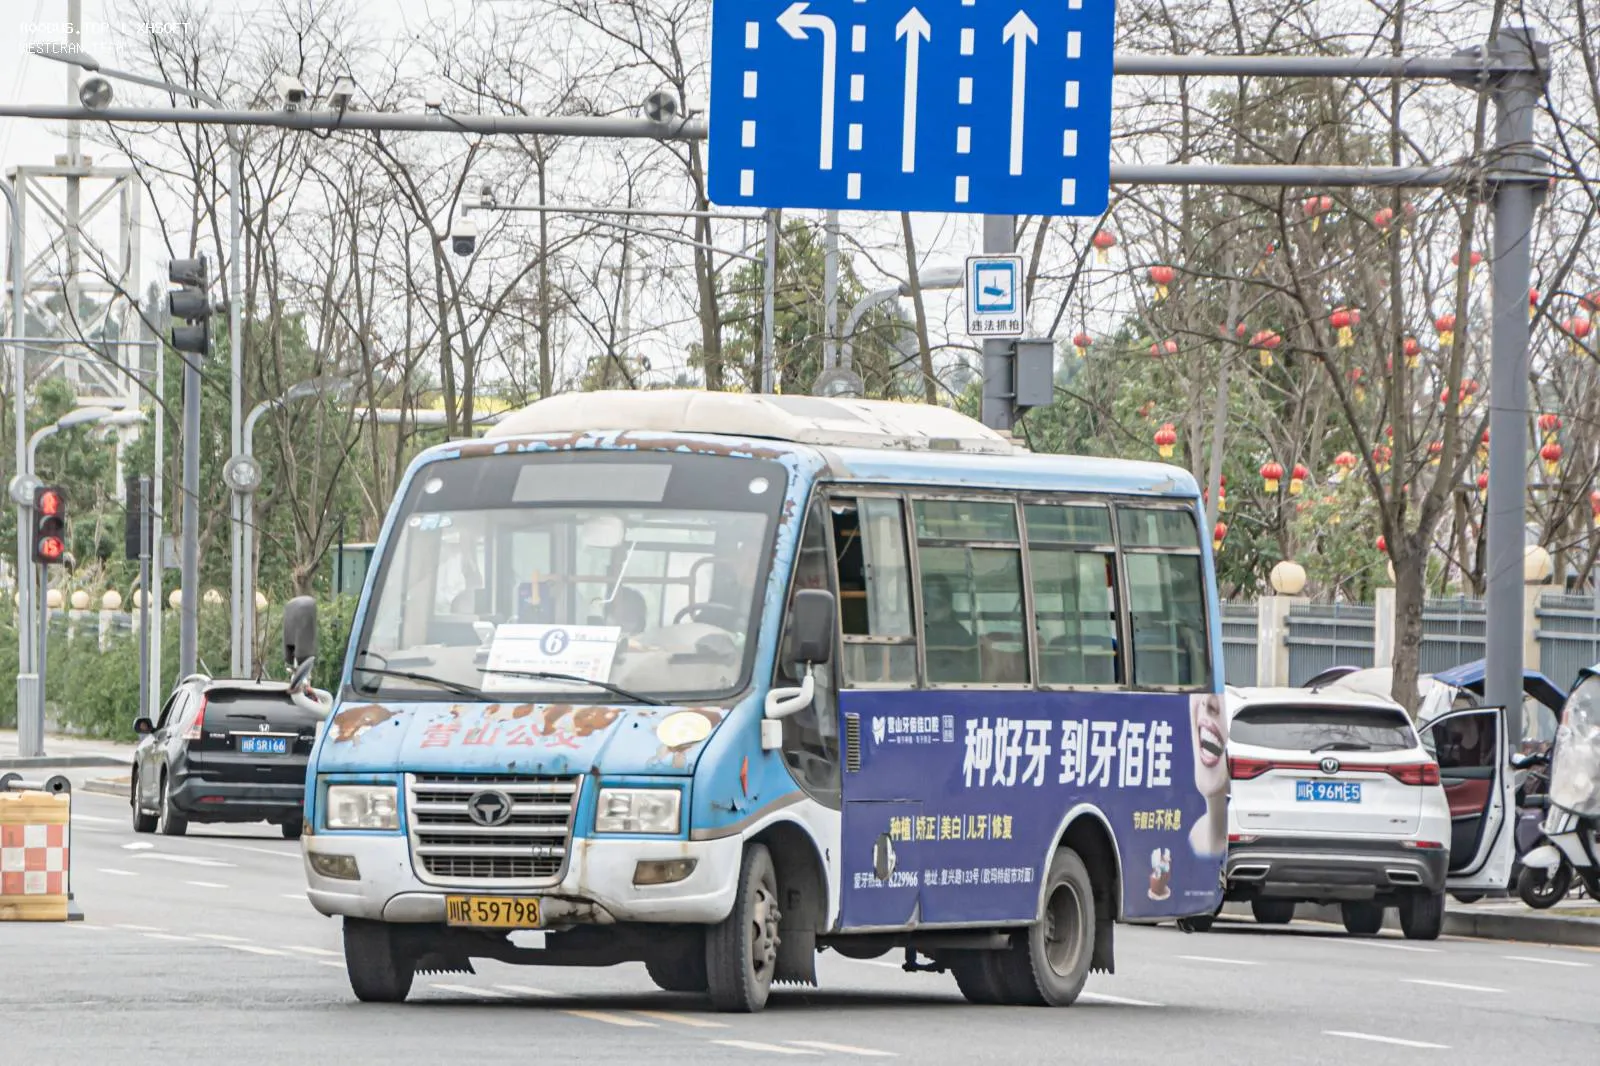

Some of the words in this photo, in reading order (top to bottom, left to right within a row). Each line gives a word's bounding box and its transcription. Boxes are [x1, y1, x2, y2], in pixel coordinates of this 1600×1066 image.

[972, 319, 1020, 332] 违法抓拍
[418, 722, 584, 750] 营山公交
[963, 717, 1053, 788] 种好牙
[1058, 720, 1173, 788] 到牙佰佳
[1133, 808, 1181, 831] 节假日不休息
